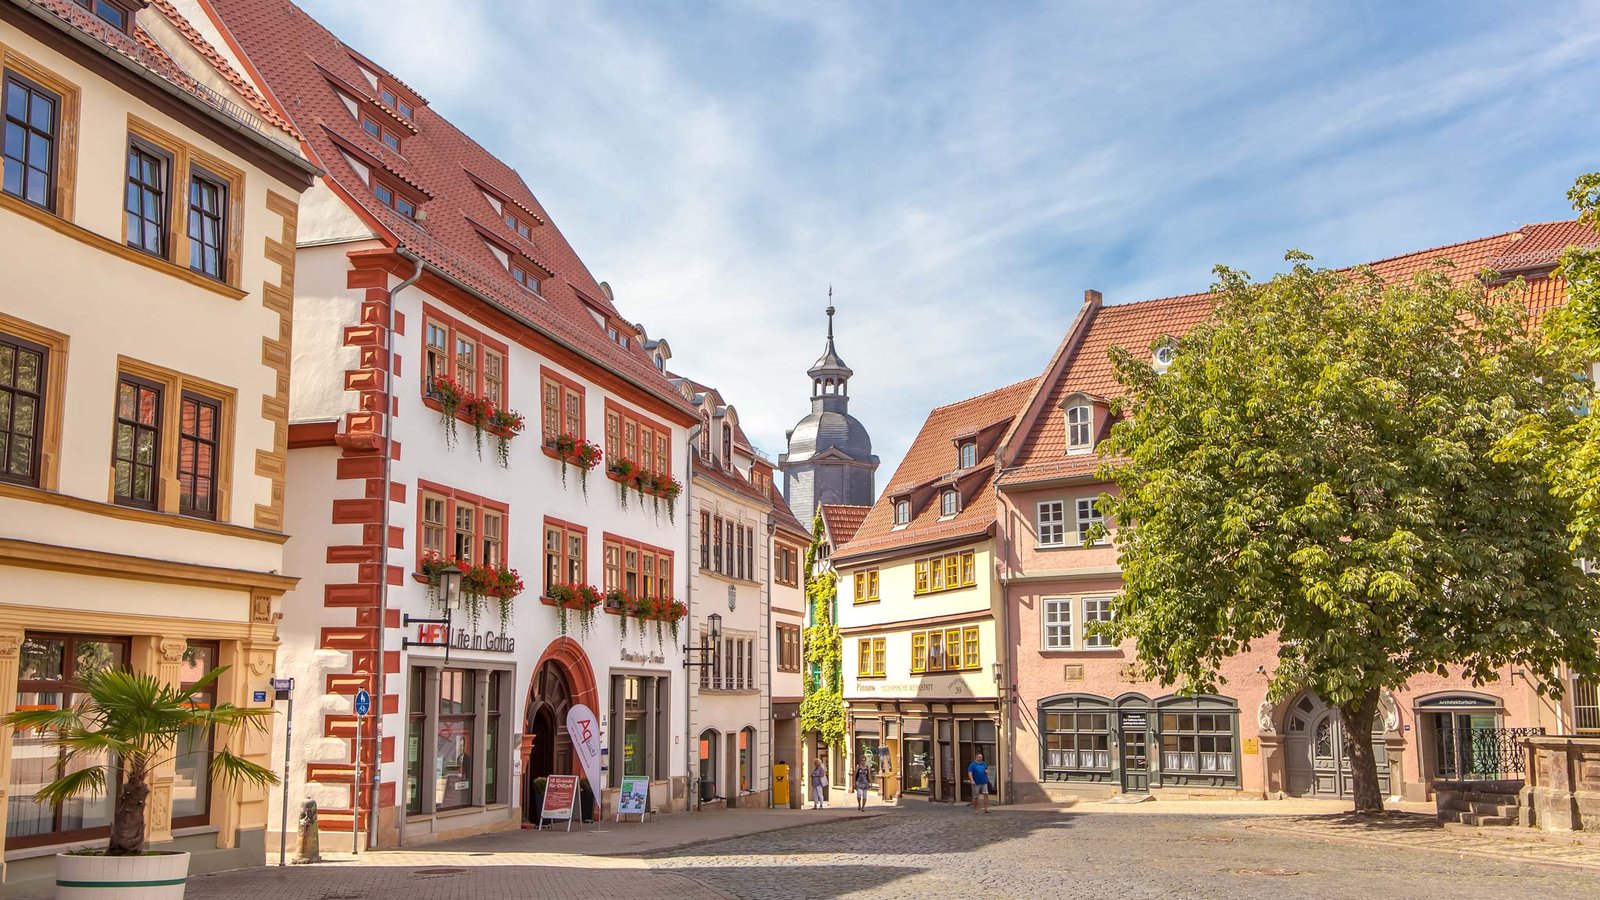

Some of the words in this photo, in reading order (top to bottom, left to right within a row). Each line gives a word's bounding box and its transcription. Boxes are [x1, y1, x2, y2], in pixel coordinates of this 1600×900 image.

[451, 628, 470, 649] Life
[473, 632, 482, 650] in
[486, 631, 515, 652] Gotha
